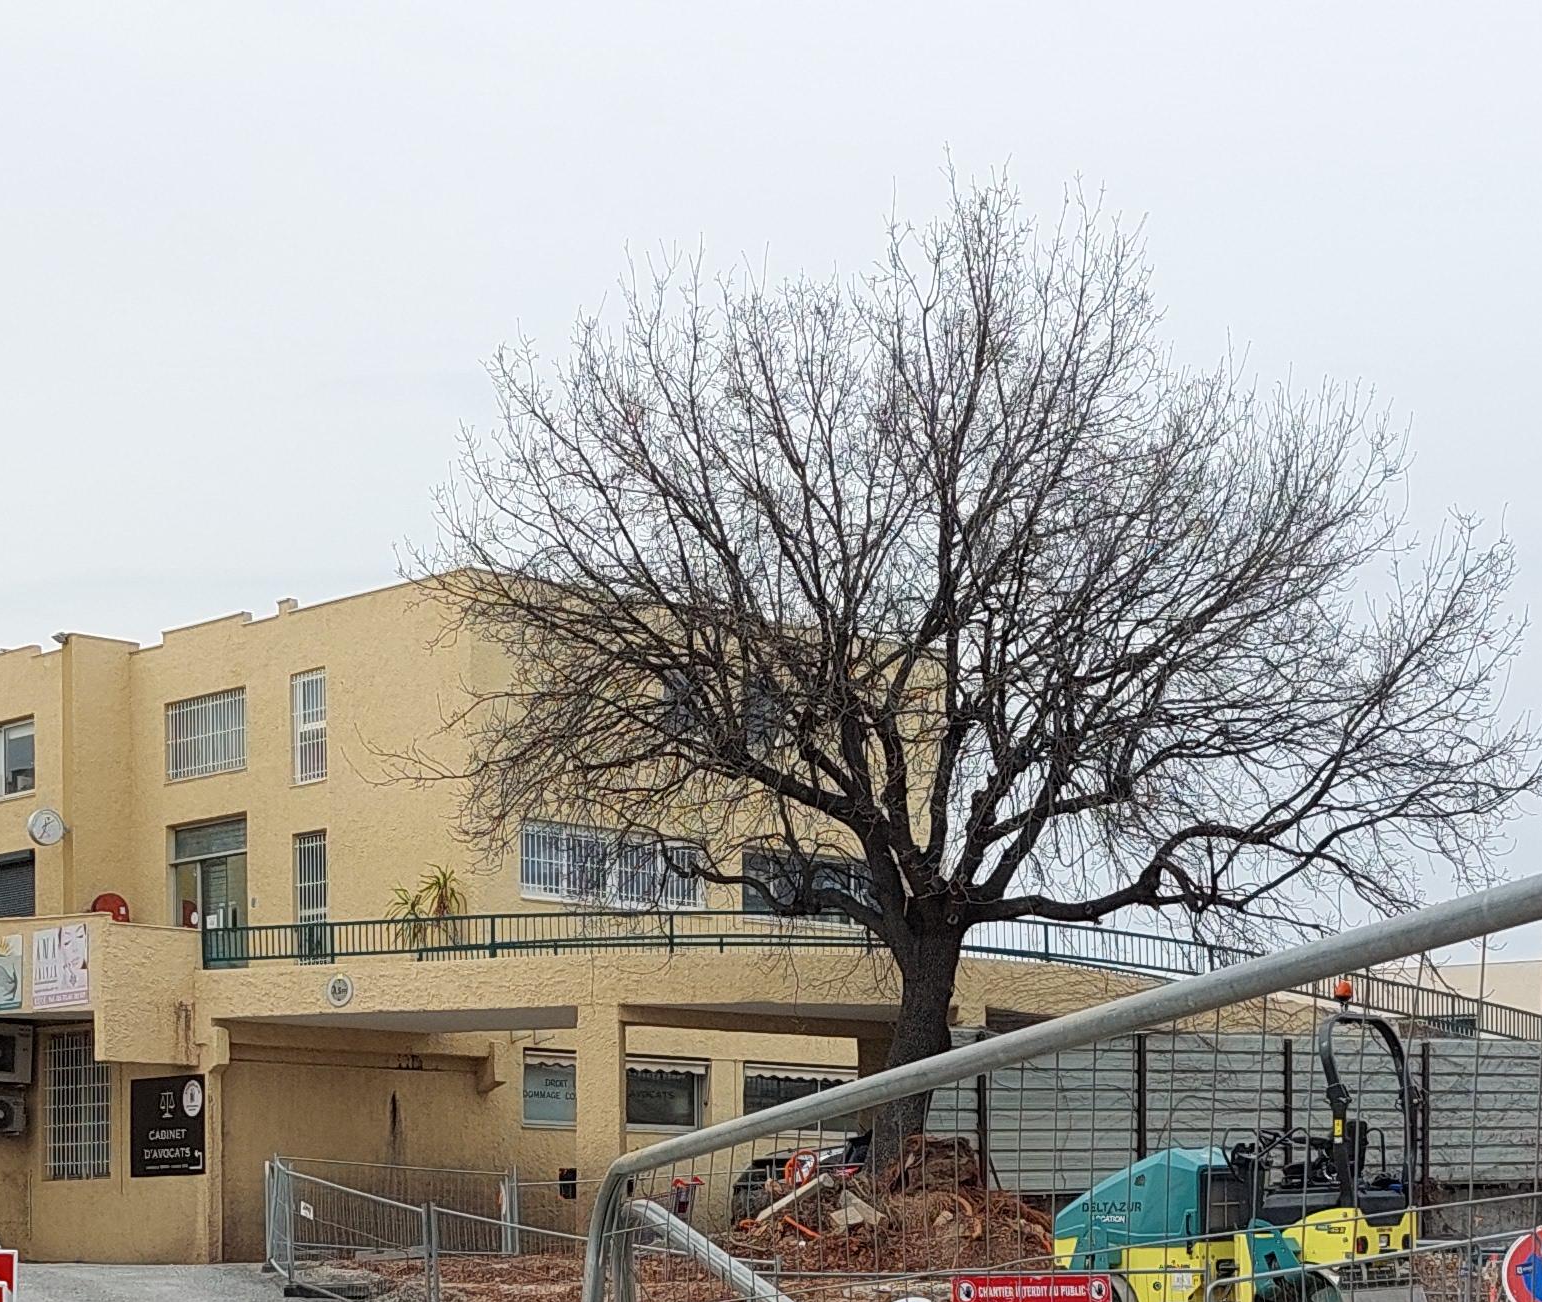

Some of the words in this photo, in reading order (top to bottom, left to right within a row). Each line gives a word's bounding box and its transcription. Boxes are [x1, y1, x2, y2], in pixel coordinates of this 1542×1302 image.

[545, 1079, 568, 1088] DROIT
[149, 1128, 187, 1140] CABINET
[144, 1147, 191, 1159] D'AVOCATS
[978, 1286, 1013, 1298] CHANTIER
[1061, 1285, 1086, 1297] PUBLIC
